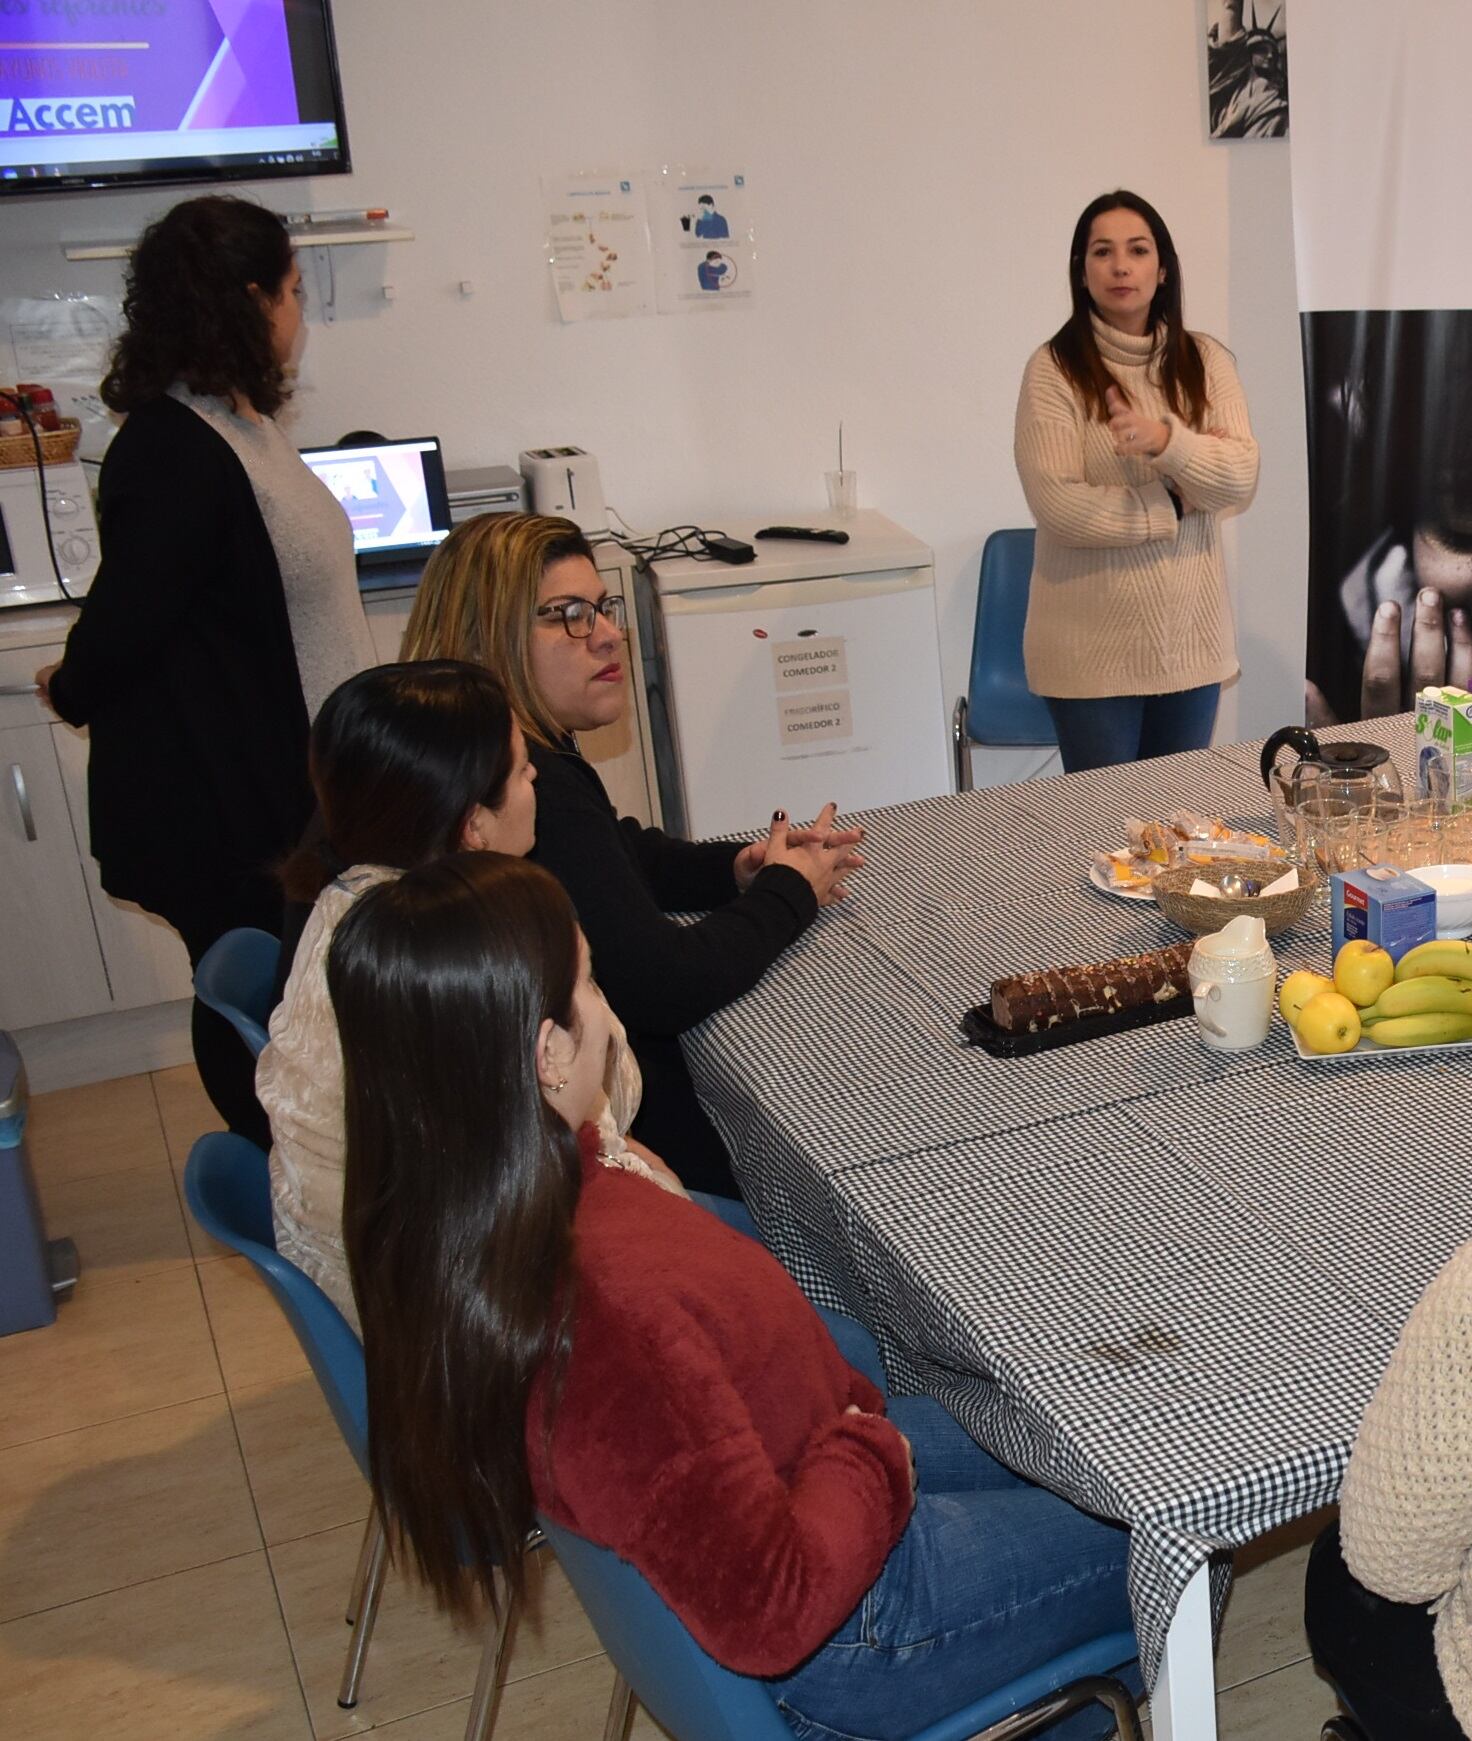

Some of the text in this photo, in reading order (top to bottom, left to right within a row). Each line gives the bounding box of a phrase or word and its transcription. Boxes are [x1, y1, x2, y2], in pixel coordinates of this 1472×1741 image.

[8, 96, 134, 131] Accem
[777, 649, 840, 664] CONGELADOR
[783, 664, 830, 678] COMEDOR
[787, 719, 834, 732] COMEDOR
